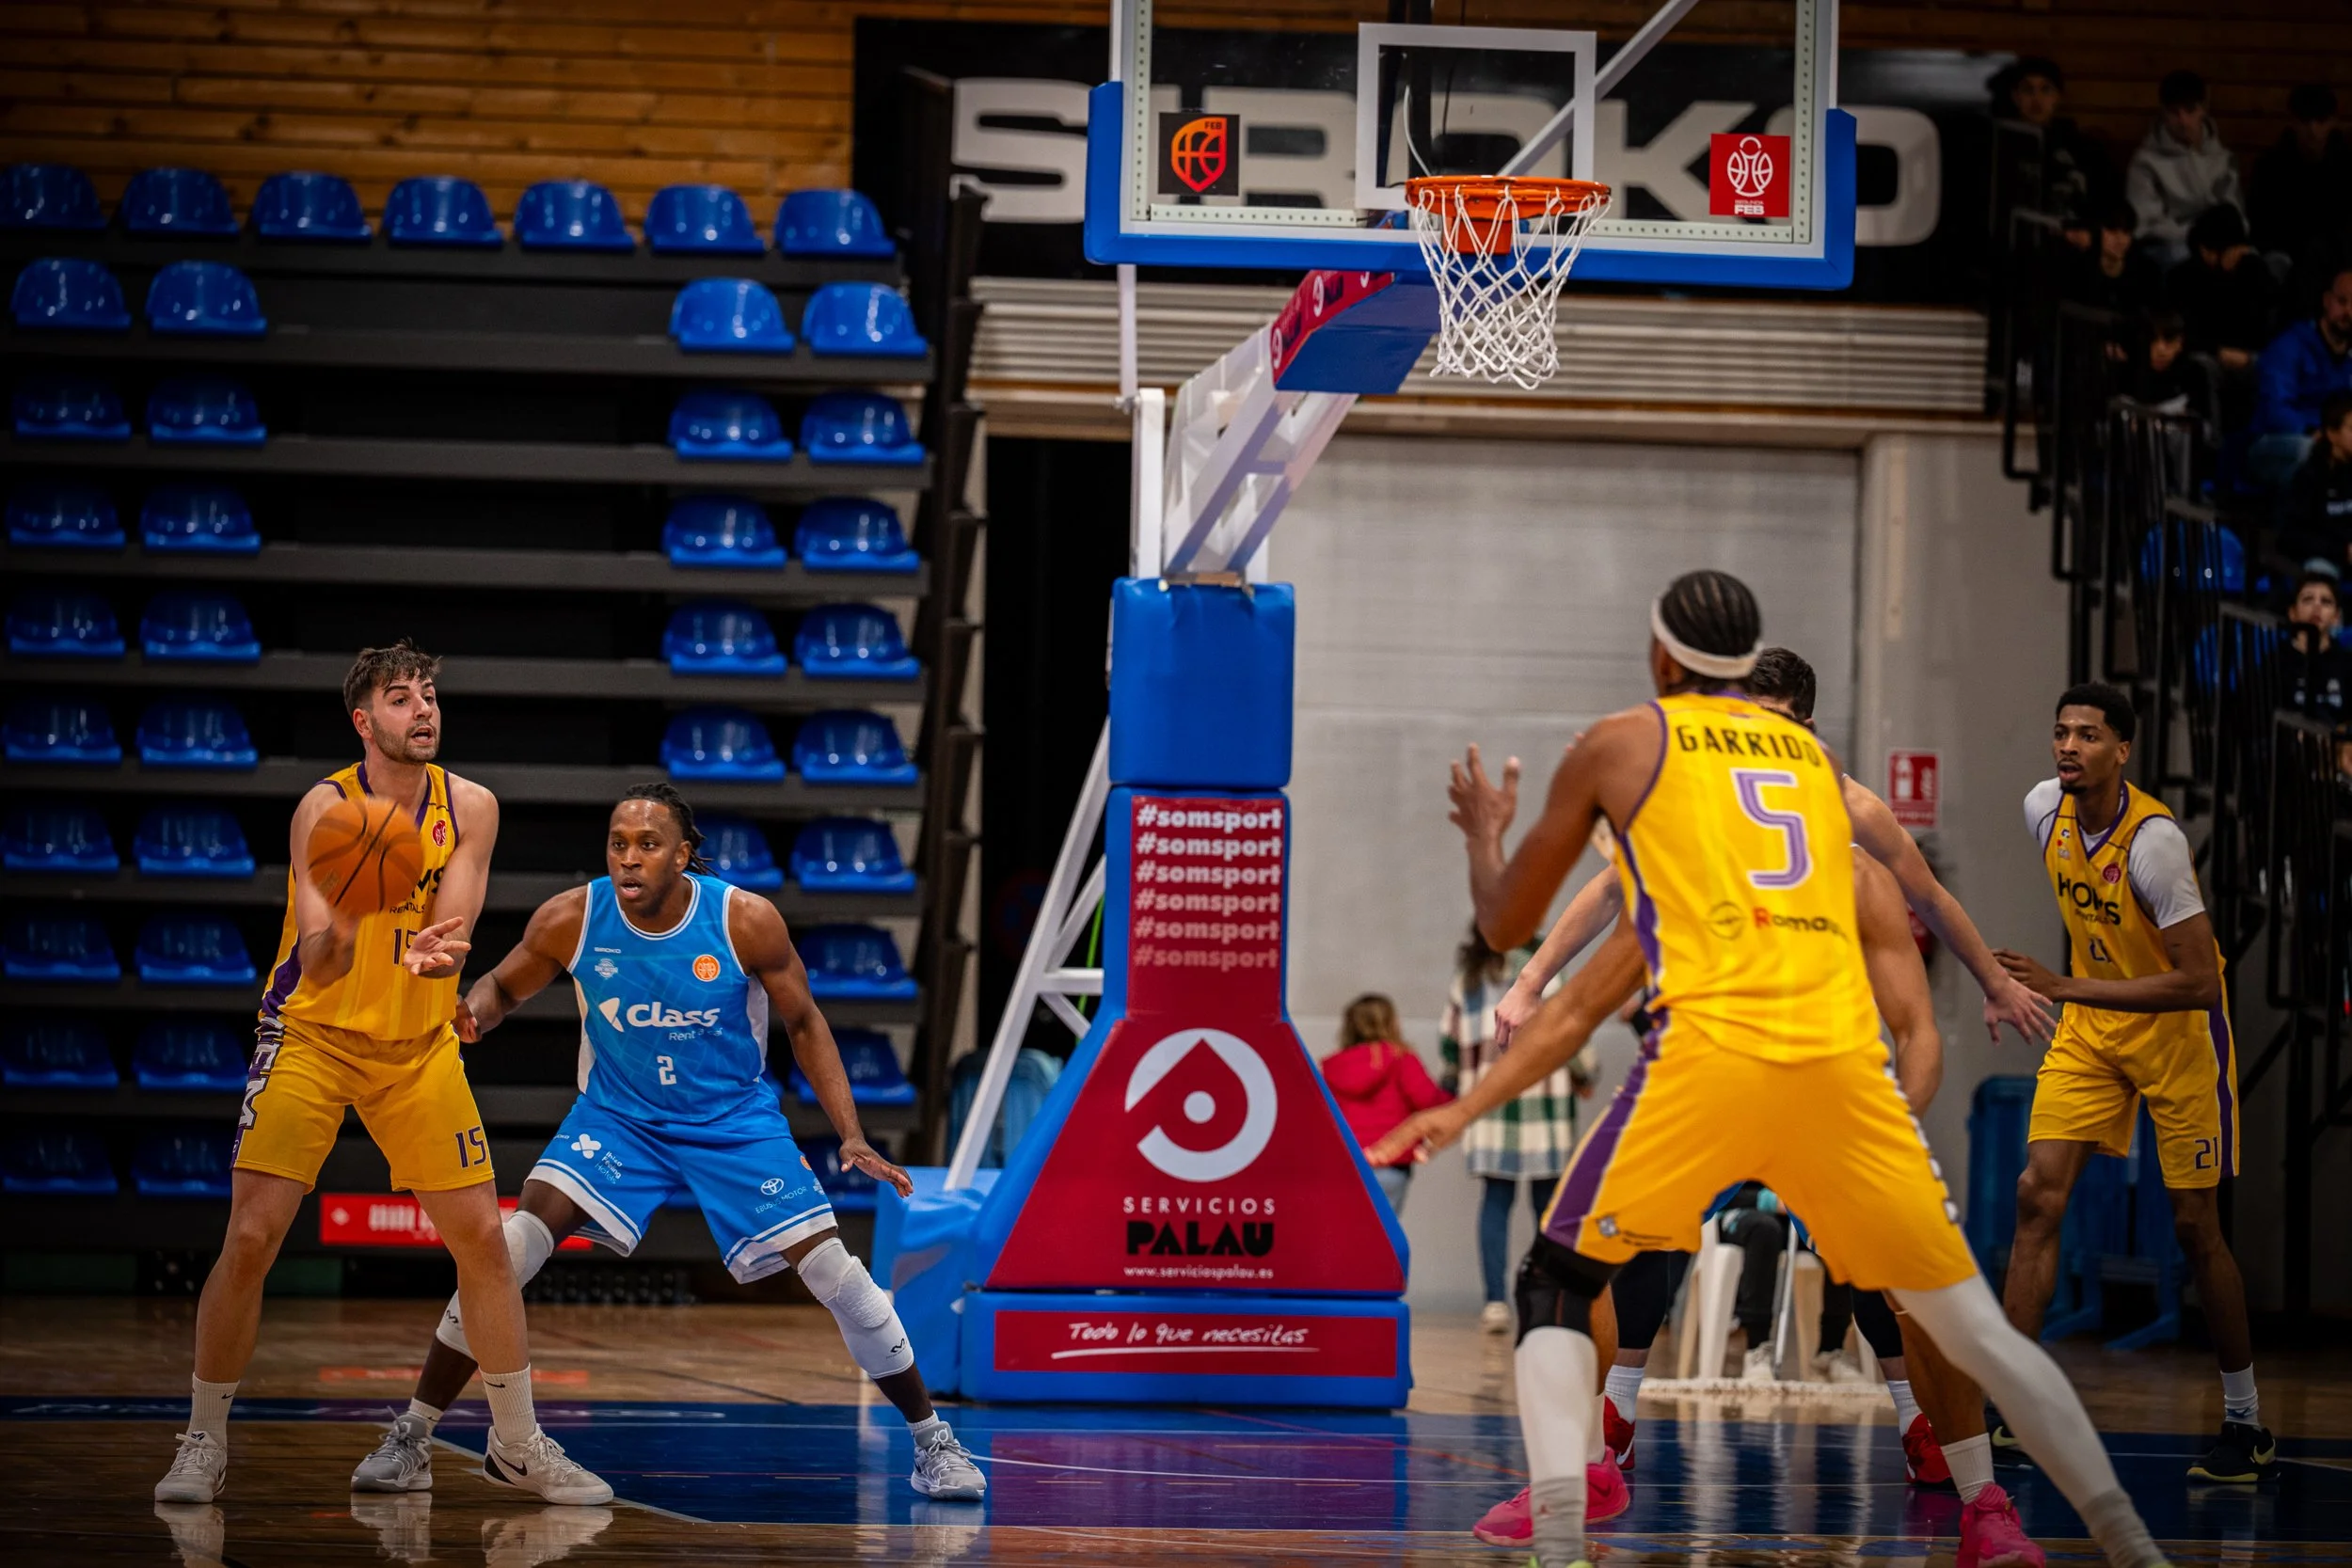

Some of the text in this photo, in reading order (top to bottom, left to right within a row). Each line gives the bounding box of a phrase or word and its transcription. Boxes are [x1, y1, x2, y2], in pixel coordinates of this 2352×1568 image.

[1205, 121, 1222, 130] FEB
[953, 77, 1941, 248] SROKO
[1735, 205, 1765, 214] FEB
[1676, 725, 1822, 768] GARRIDO
[1136, 804, 1283, 832] #somsport
[1730, 768, 1812, 889] 5
[1136, 832, 1282, 861] #somsport
[1136, 861, 1281, 889] #somsport
[1136, 889, 1280, 916] #somsport
[1135, 917, 1279, 944] #somsport
[1135, 945, 1279, 973] #somsport
[626, 1001, 721, 1027] Class
[668, 1030, 697, 1041] Rent
[657, 1054, 677, 1085] 2
[454, 1126, 487, 1169] 15
[2195, 1135, 2220, 1170] 21
[595, 1162, 617, 1184] Hotels
[601, 1156, 622, 1180] Feeling
[755, 1186, 808, 1214] EBUSUS MOTOR
[1123, 1196, 1275, 1214] SERVICIOS
[1127, 1220, 1275, 1258] PALAU
[1123, 1263, 1275, 1282] www.serviciospalau.es
[1068, 1320, 1310, 1346] Todo lo que necesitas
